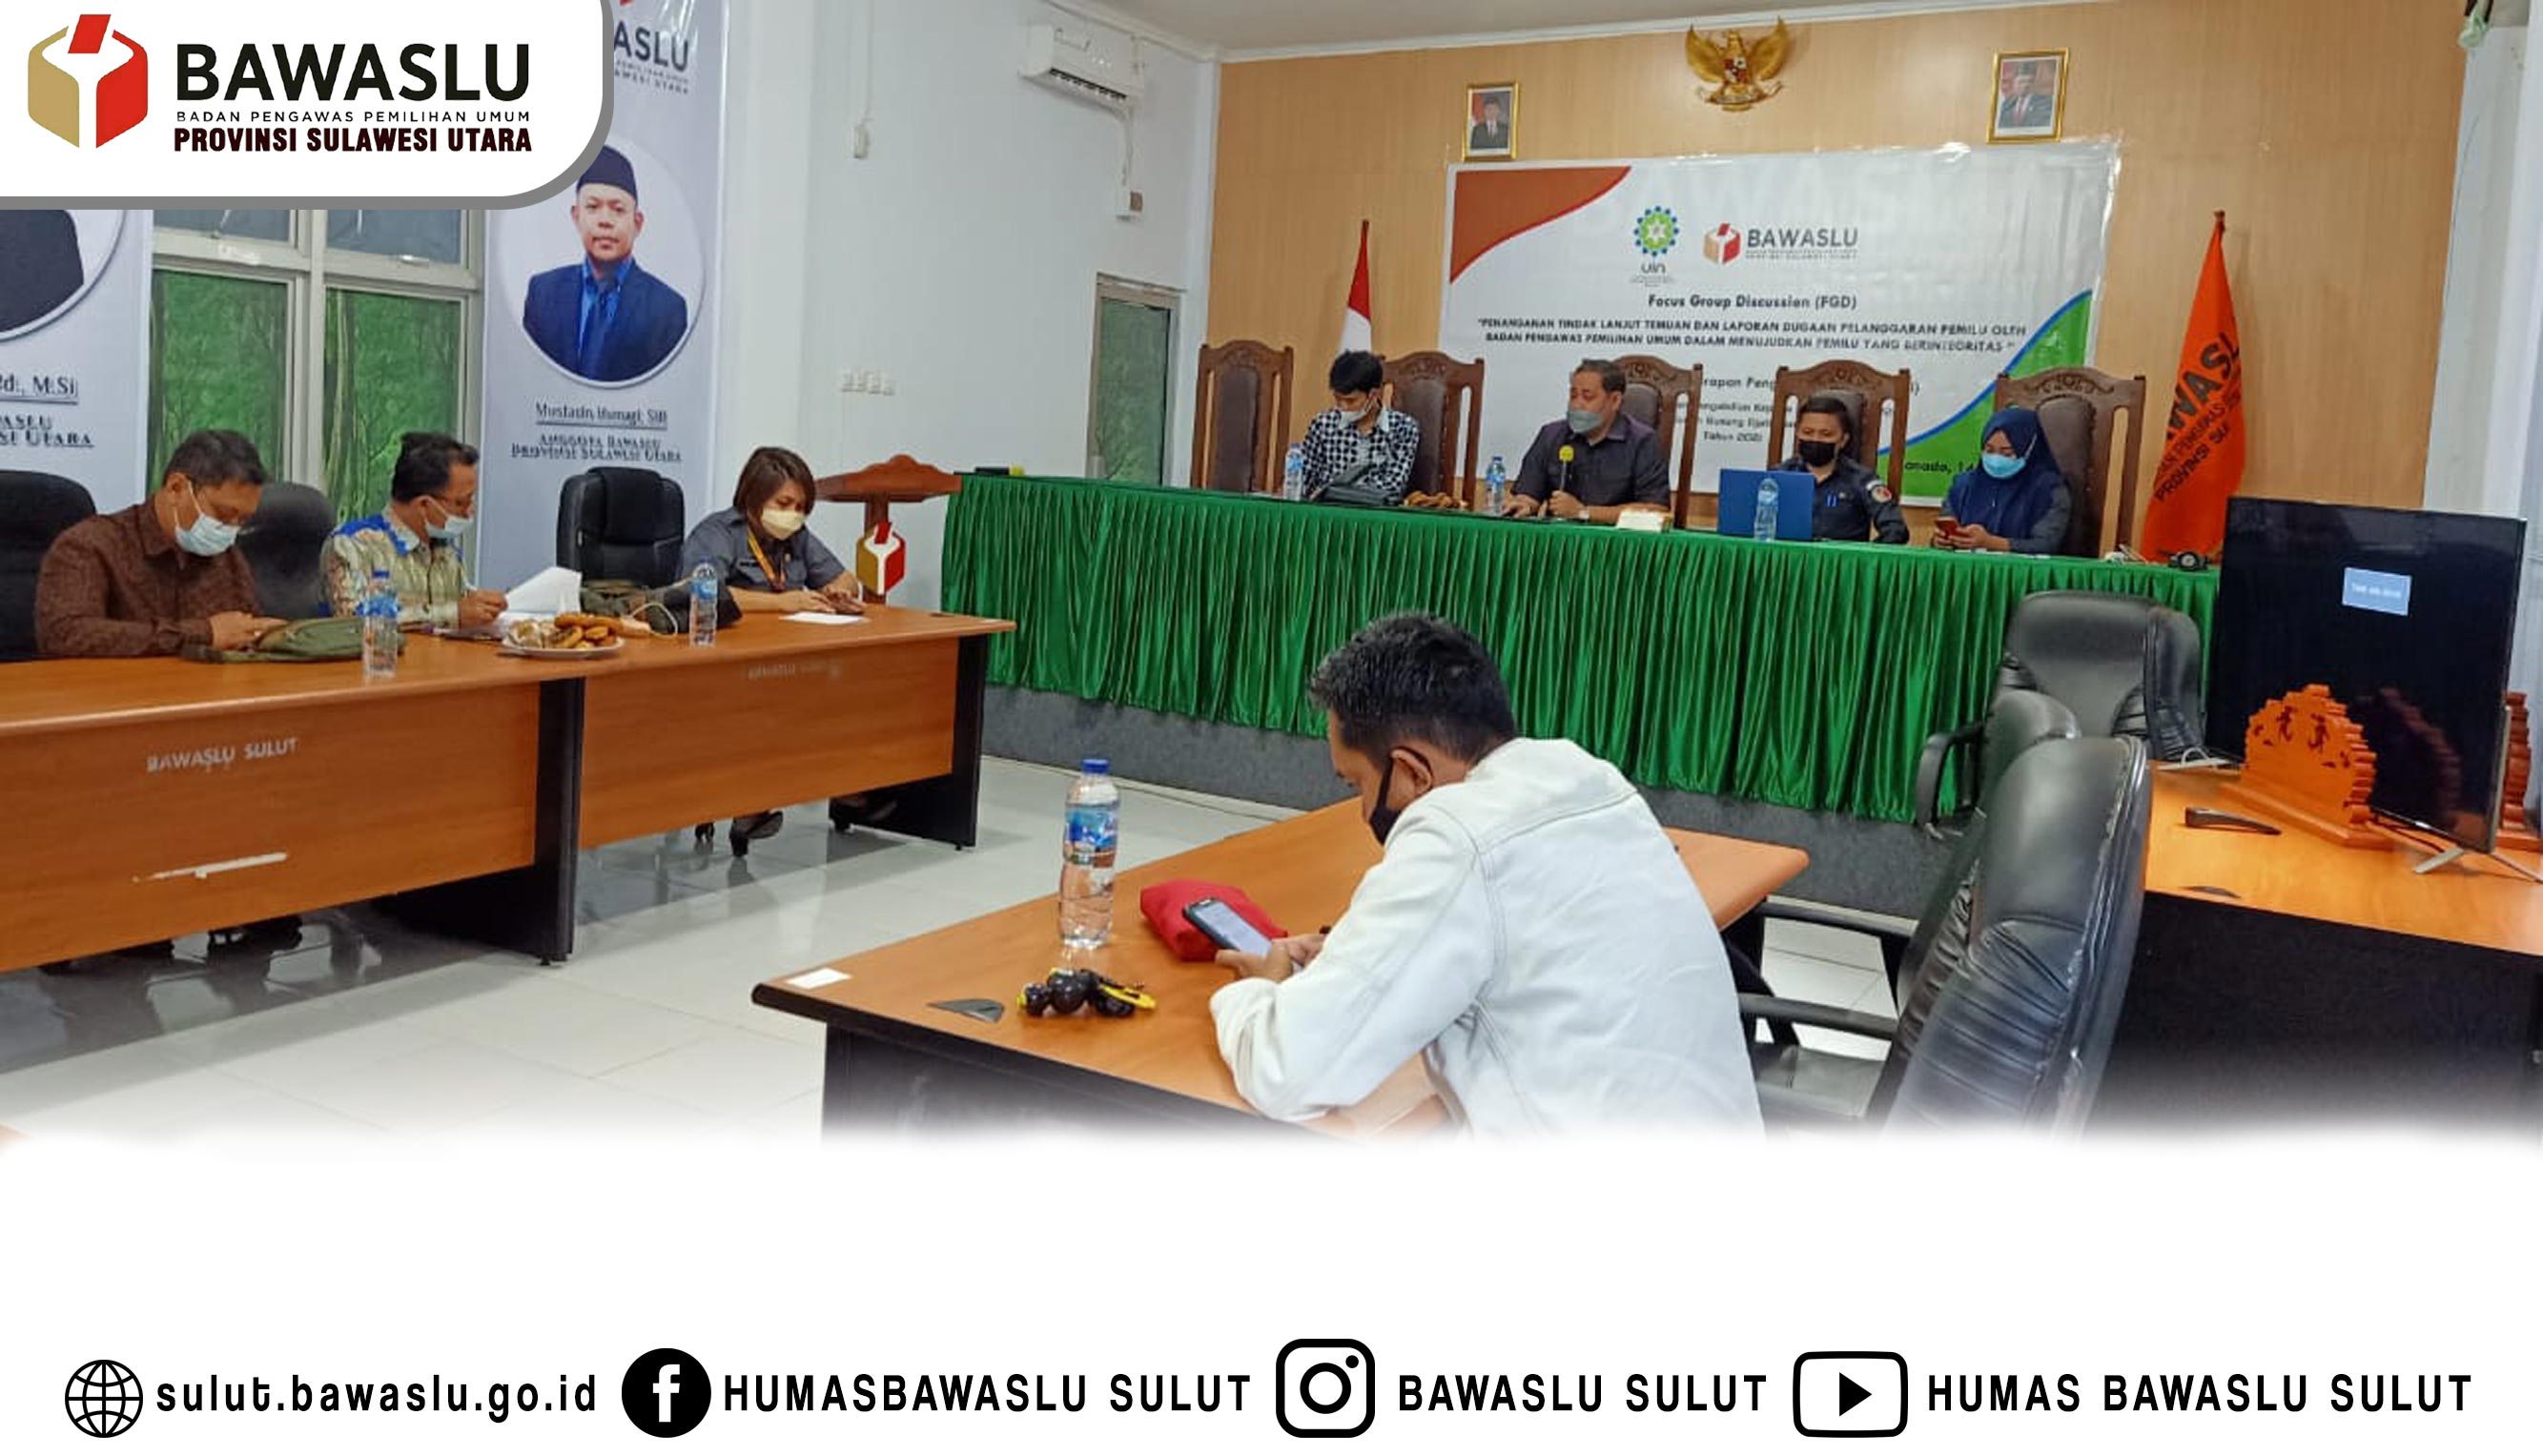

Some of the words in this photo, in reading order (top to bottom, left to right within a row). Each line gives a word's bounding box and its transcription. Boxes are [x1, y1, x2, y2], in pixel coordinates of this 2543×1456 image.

[1747, 229, 1857, 248] BAWASLU
[1649, 295, 1685, 307] Focus
[1690, 295, 1731, 310] Group
[1735, 295, 1810, 308] Discussion
[1815, 295, 1857, 311] (FGD)
[1601, 319, 1641, 330] LANJUT
[1694, 320, 1719, 331] DAN
[1723, 320, 1778, 332] LAPORAN
[1840, 322, 1937, 335] PELANGGARAN
[1486, 332, 1522, 341] BADAN
[1685, 335, 1725, 346] DALAM
[243, 737, 298, 760] SULUT
